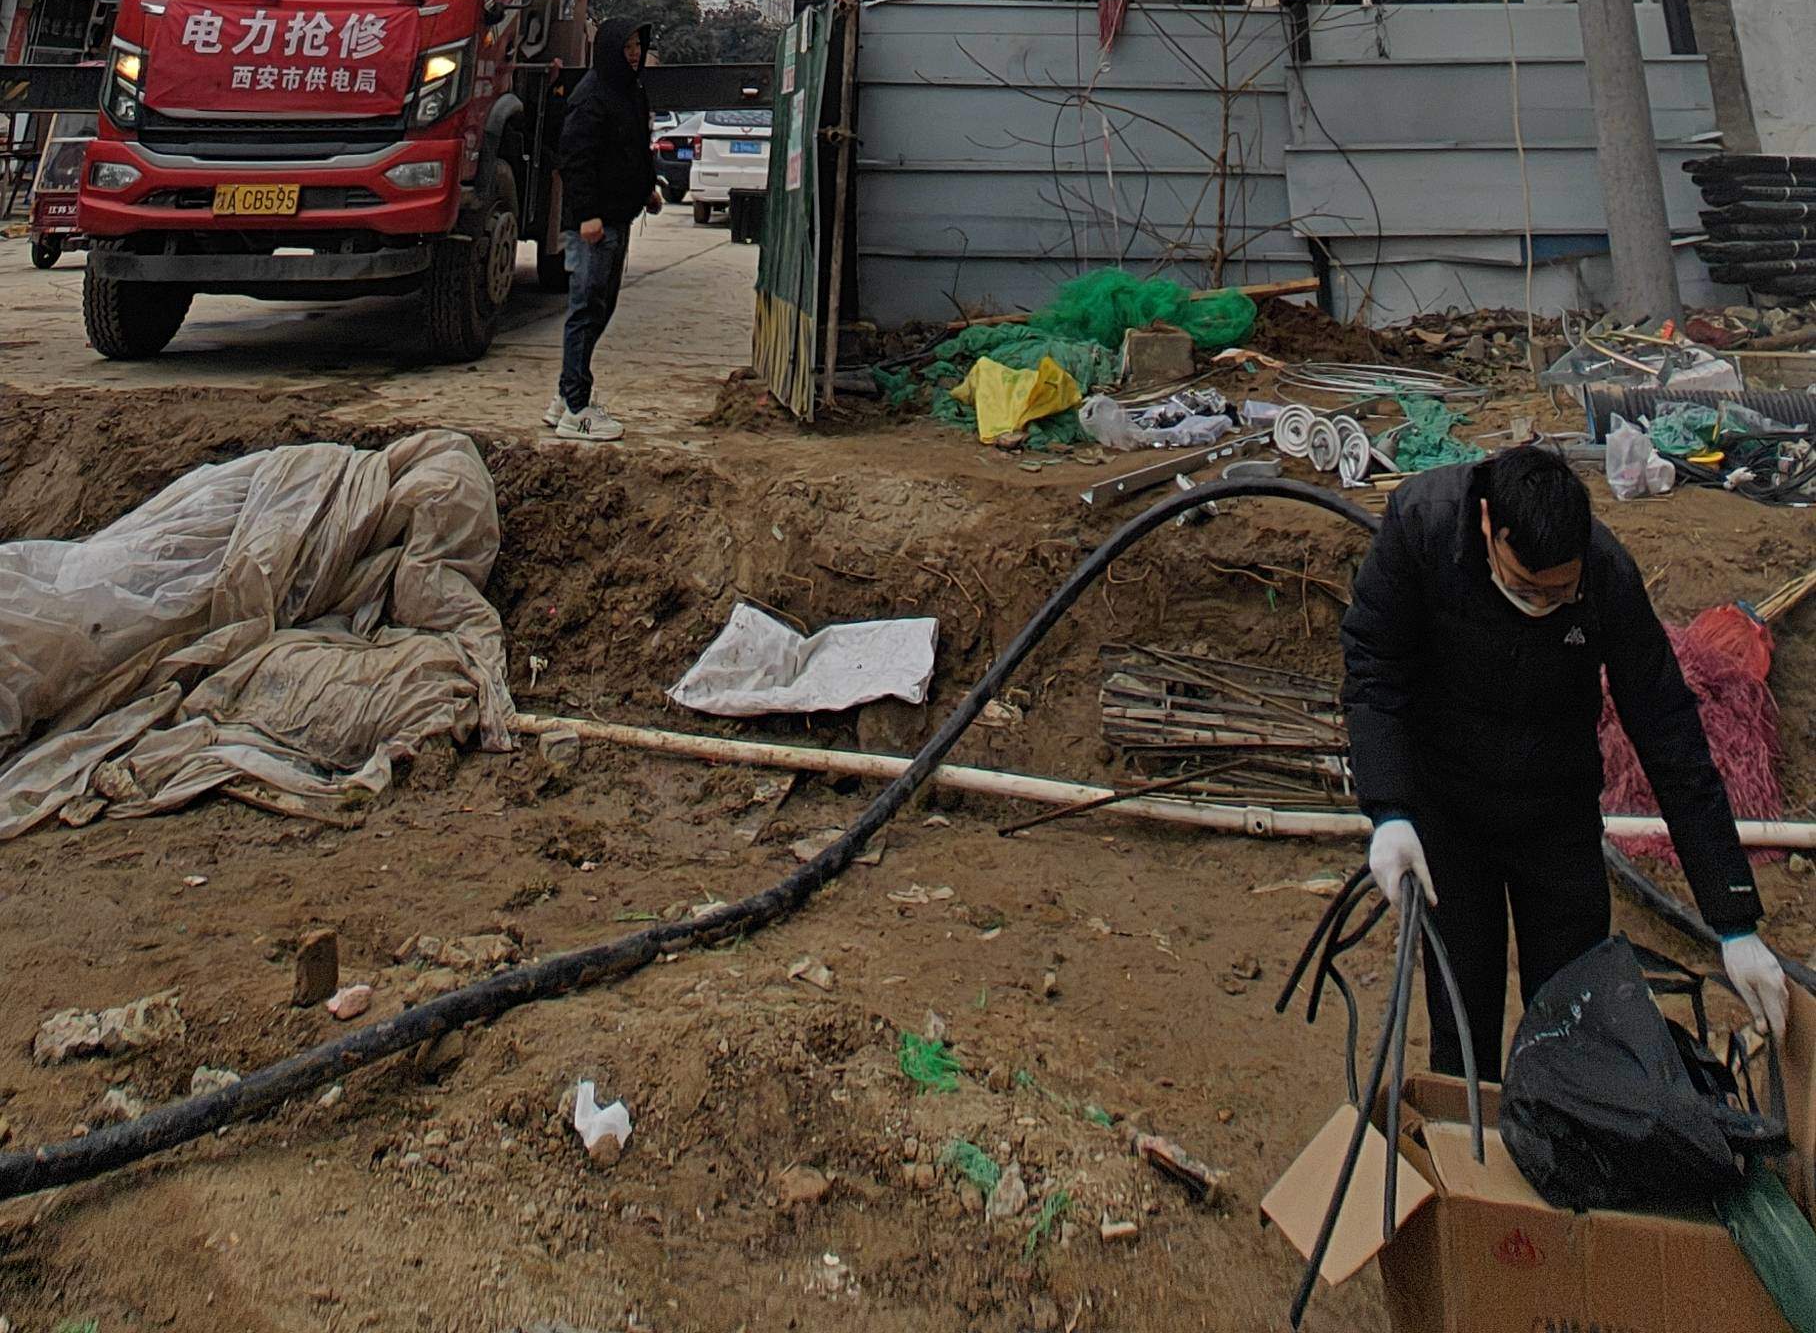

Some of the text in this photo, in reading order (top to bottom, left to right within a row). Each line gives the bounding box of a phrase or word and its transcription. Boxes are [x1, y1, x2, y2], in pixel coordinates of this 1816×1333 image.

[181, 9, 388, 60] 电力抢修
[231, 65, 377, 93] 西安市供电局
